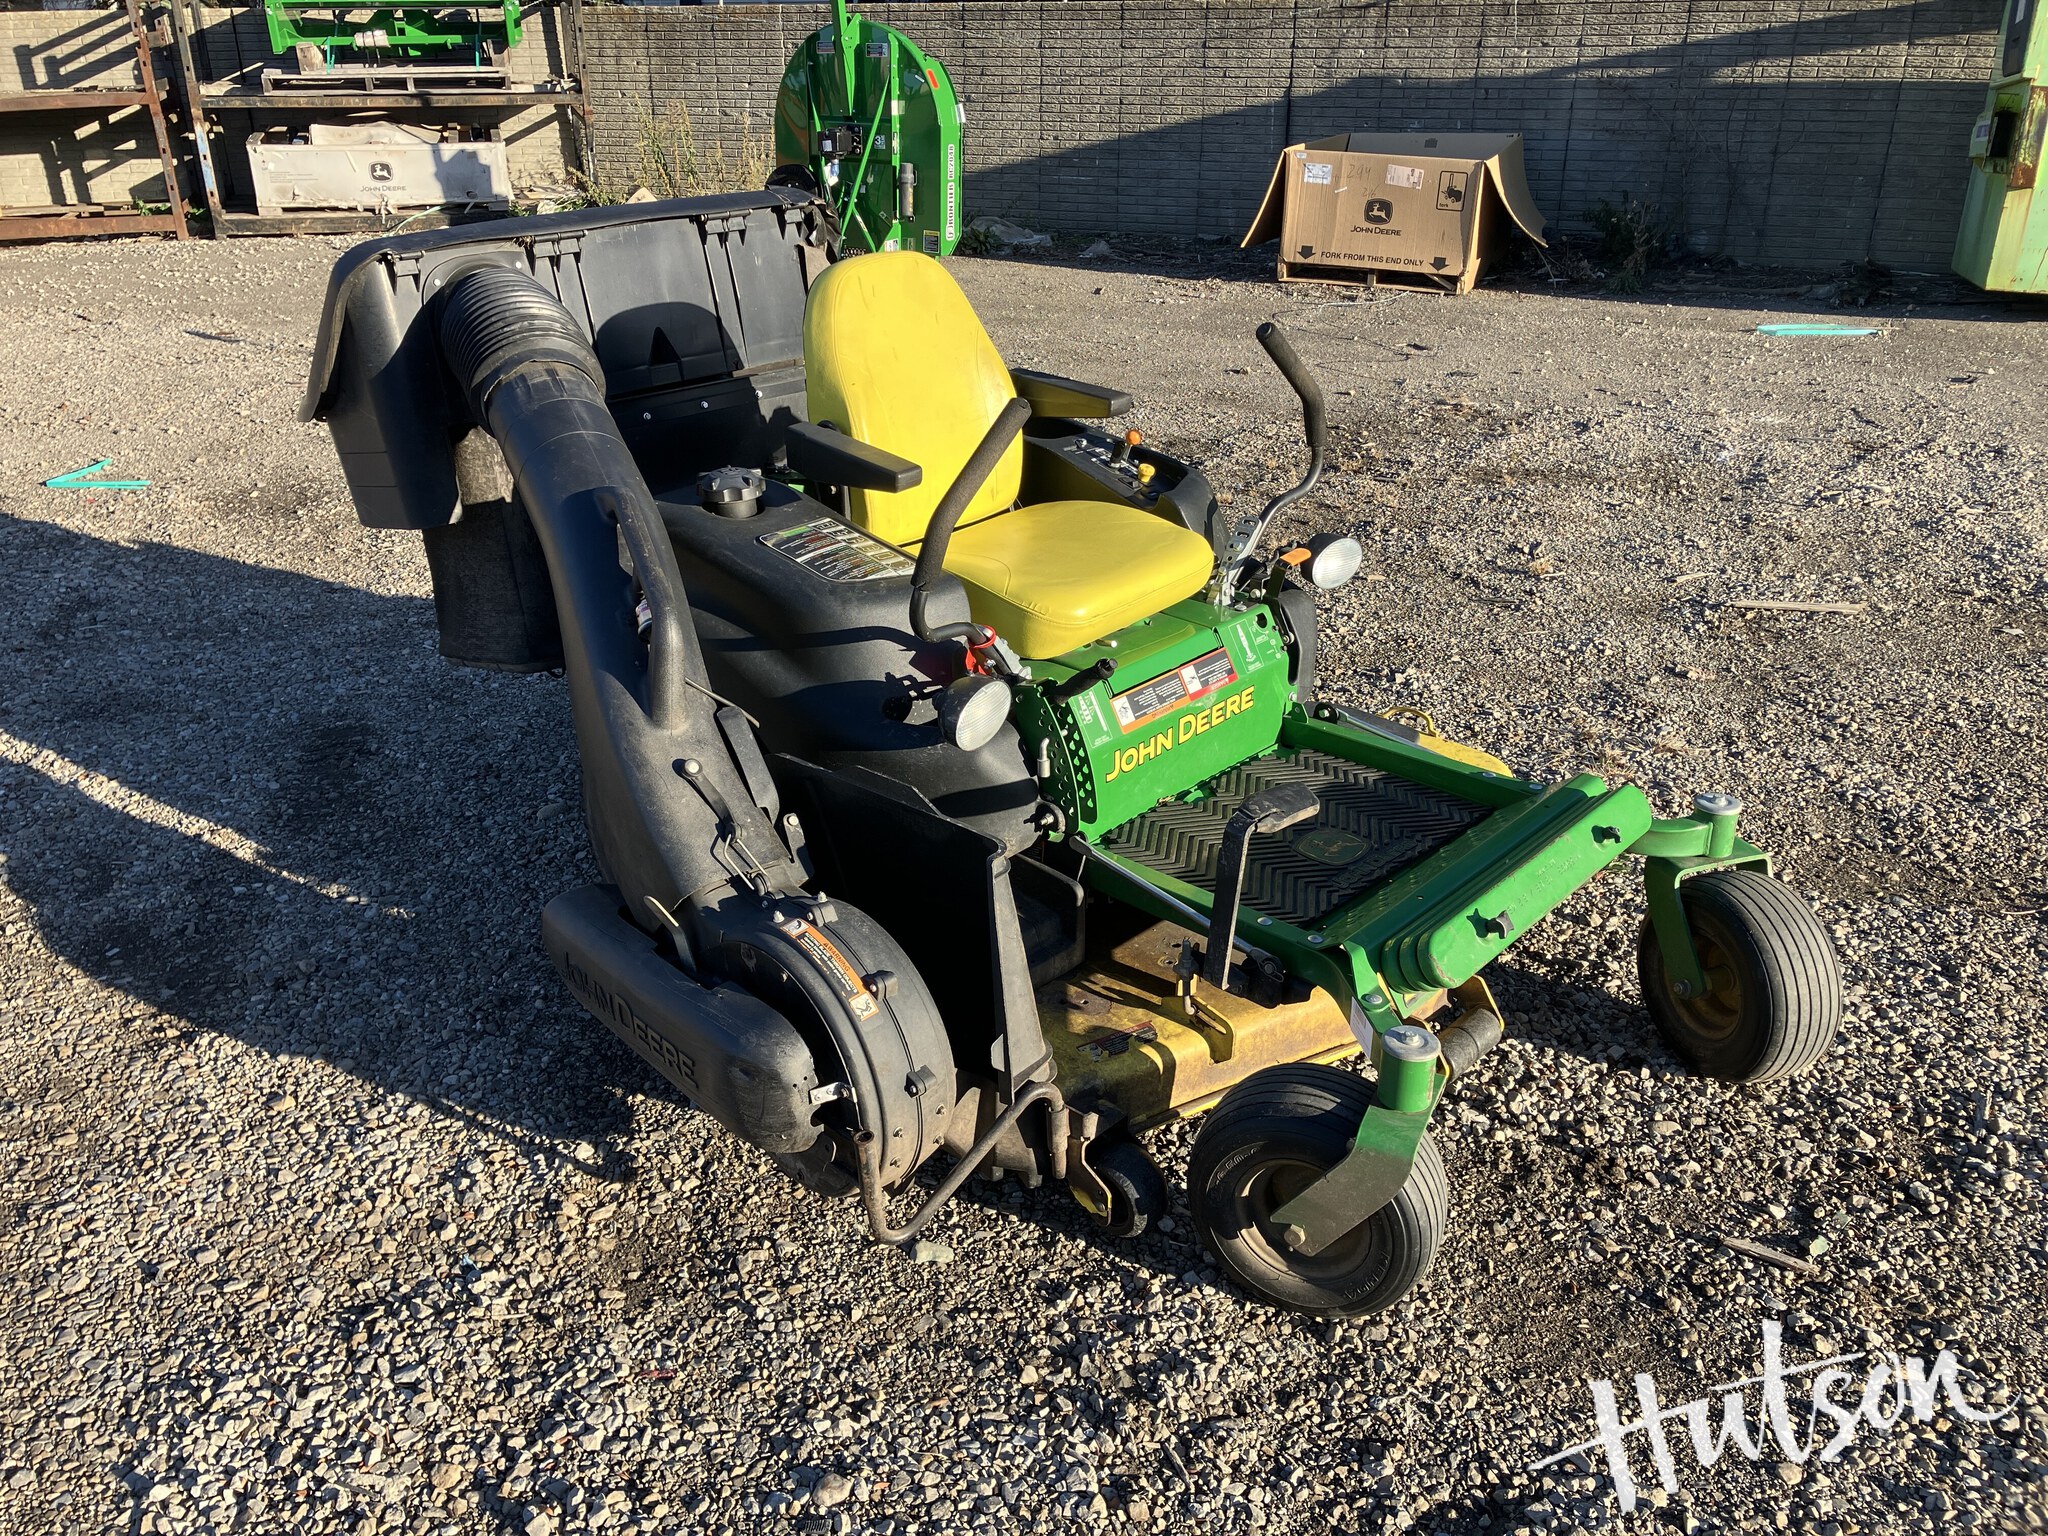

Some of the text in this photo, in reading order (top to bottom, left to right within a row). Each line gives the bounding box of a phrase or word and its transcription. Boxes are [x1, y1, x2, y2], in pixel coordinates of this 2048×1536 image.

[1350, 225, 1402, 236] JOHN DEERE
[1320, 251, 1425, 267] FORK FROM THIS END ONLY
[1106, 726, 1174, 784] JOHN
[1178, 684, 1256, 746] DEERE
[827, 945, 851, 972] WARNING
[563, 950, 700, 1091] JOHN DEERE
